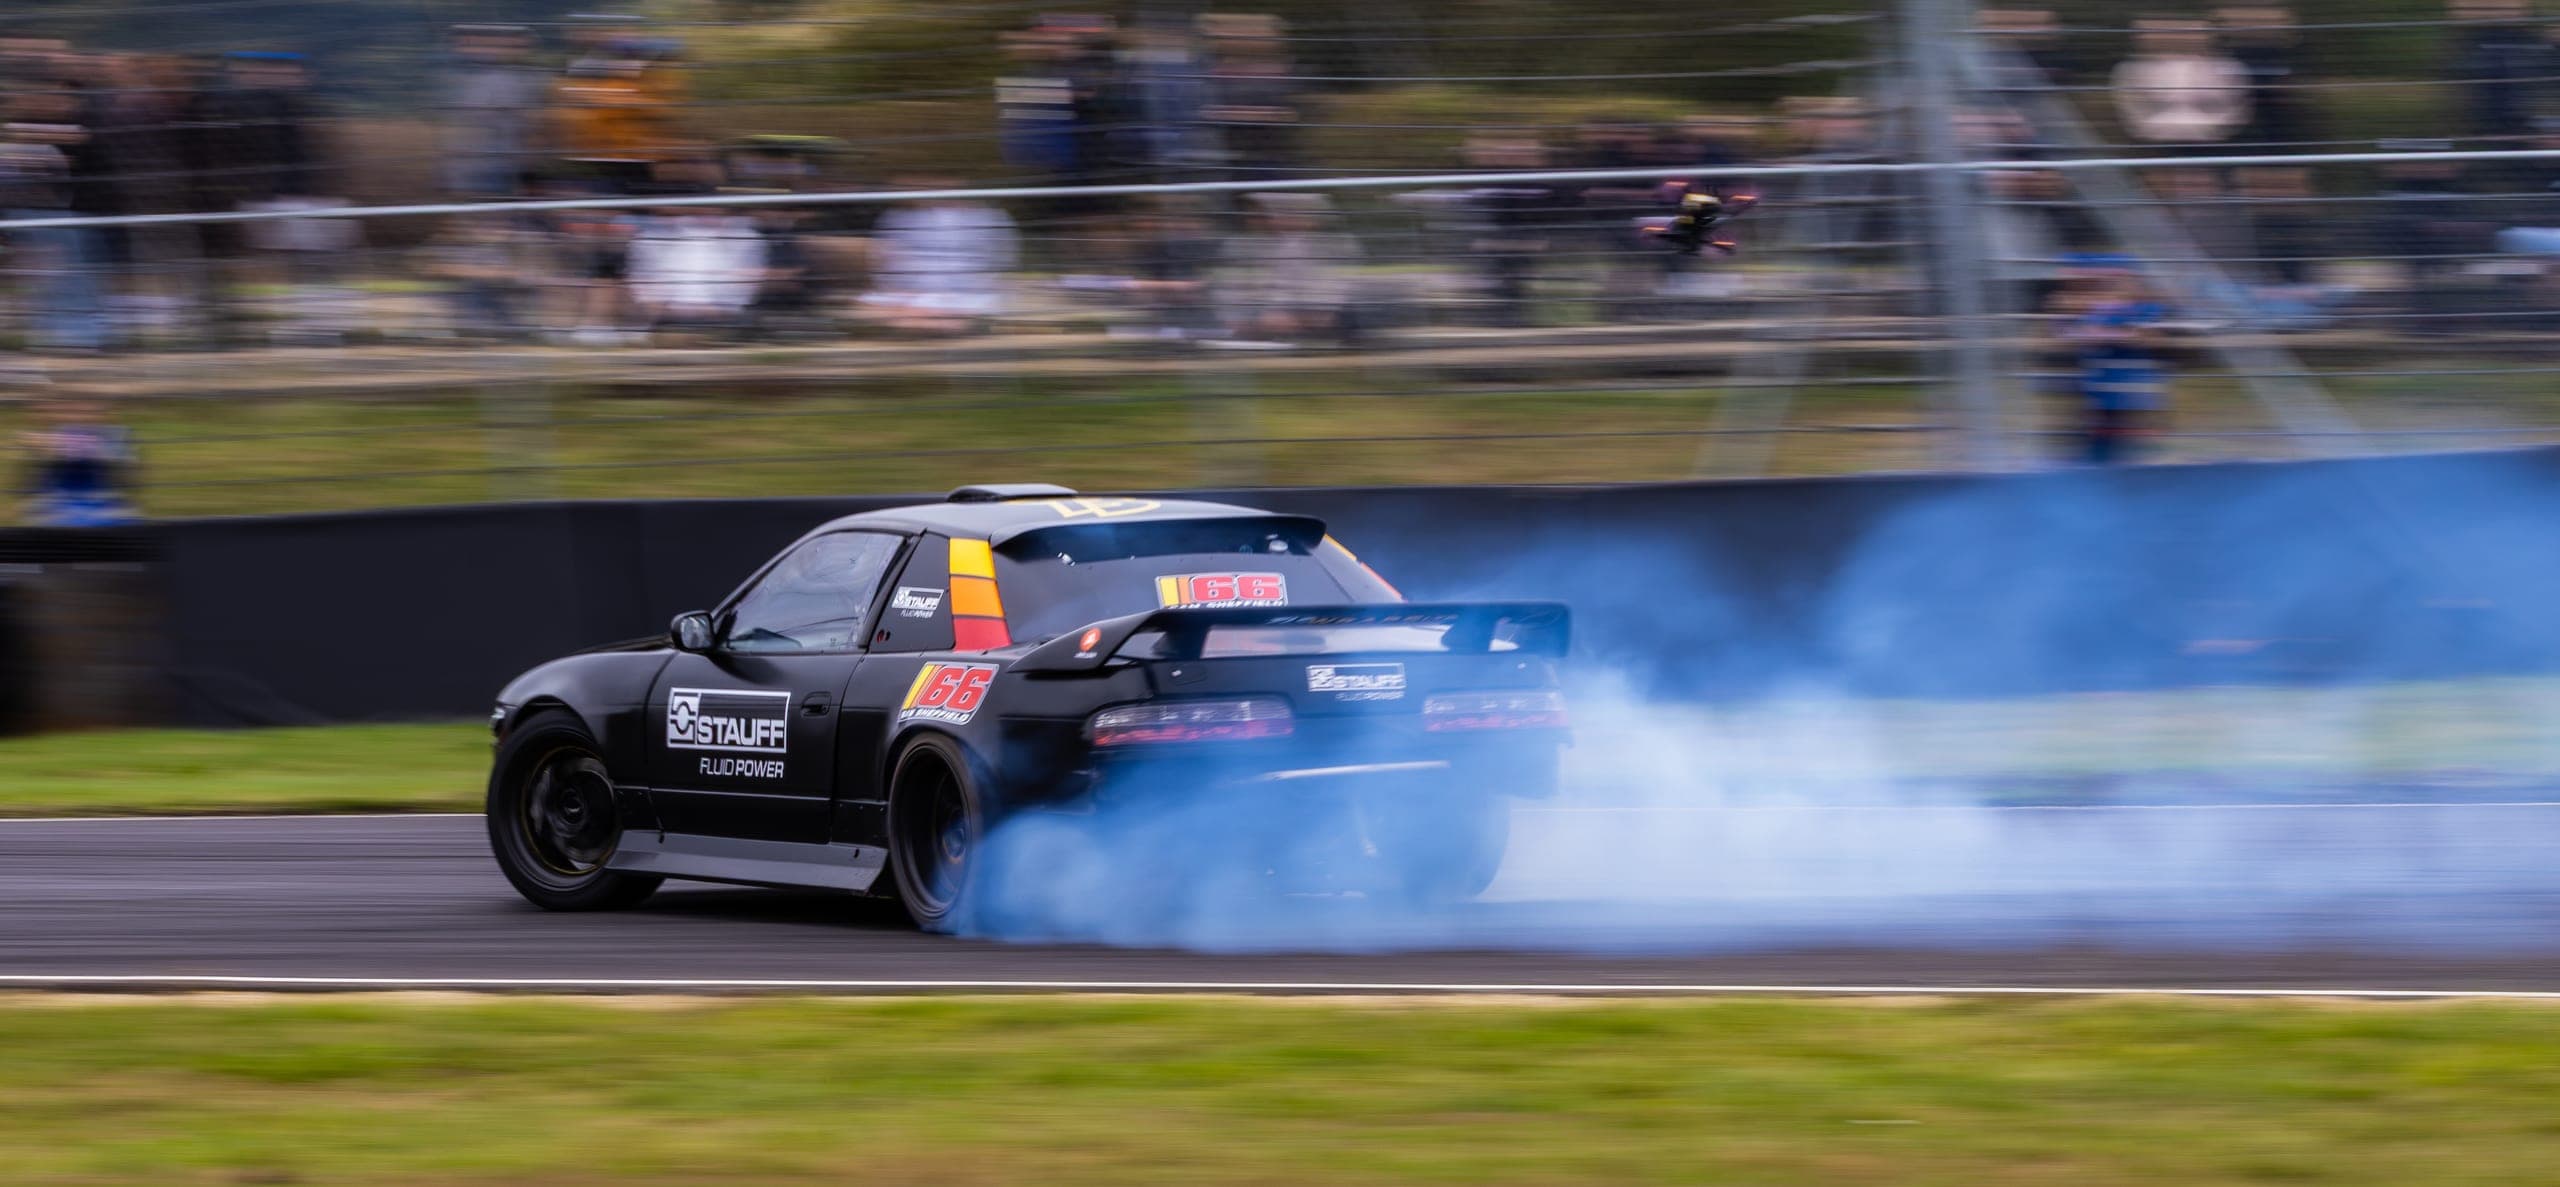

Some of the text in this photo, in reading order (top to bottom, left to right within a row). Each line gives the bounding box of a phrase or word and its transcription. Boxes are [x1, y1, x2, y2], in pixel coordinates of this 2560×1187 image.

[904, 596, 939, 609] STAUFF
[1190, 575, 1283, 603] 66
[917, 664, 995, 713] 66
[697, 715, 785, 747] STAUFF
[699, 757, 784, 778] FLUID POWER
